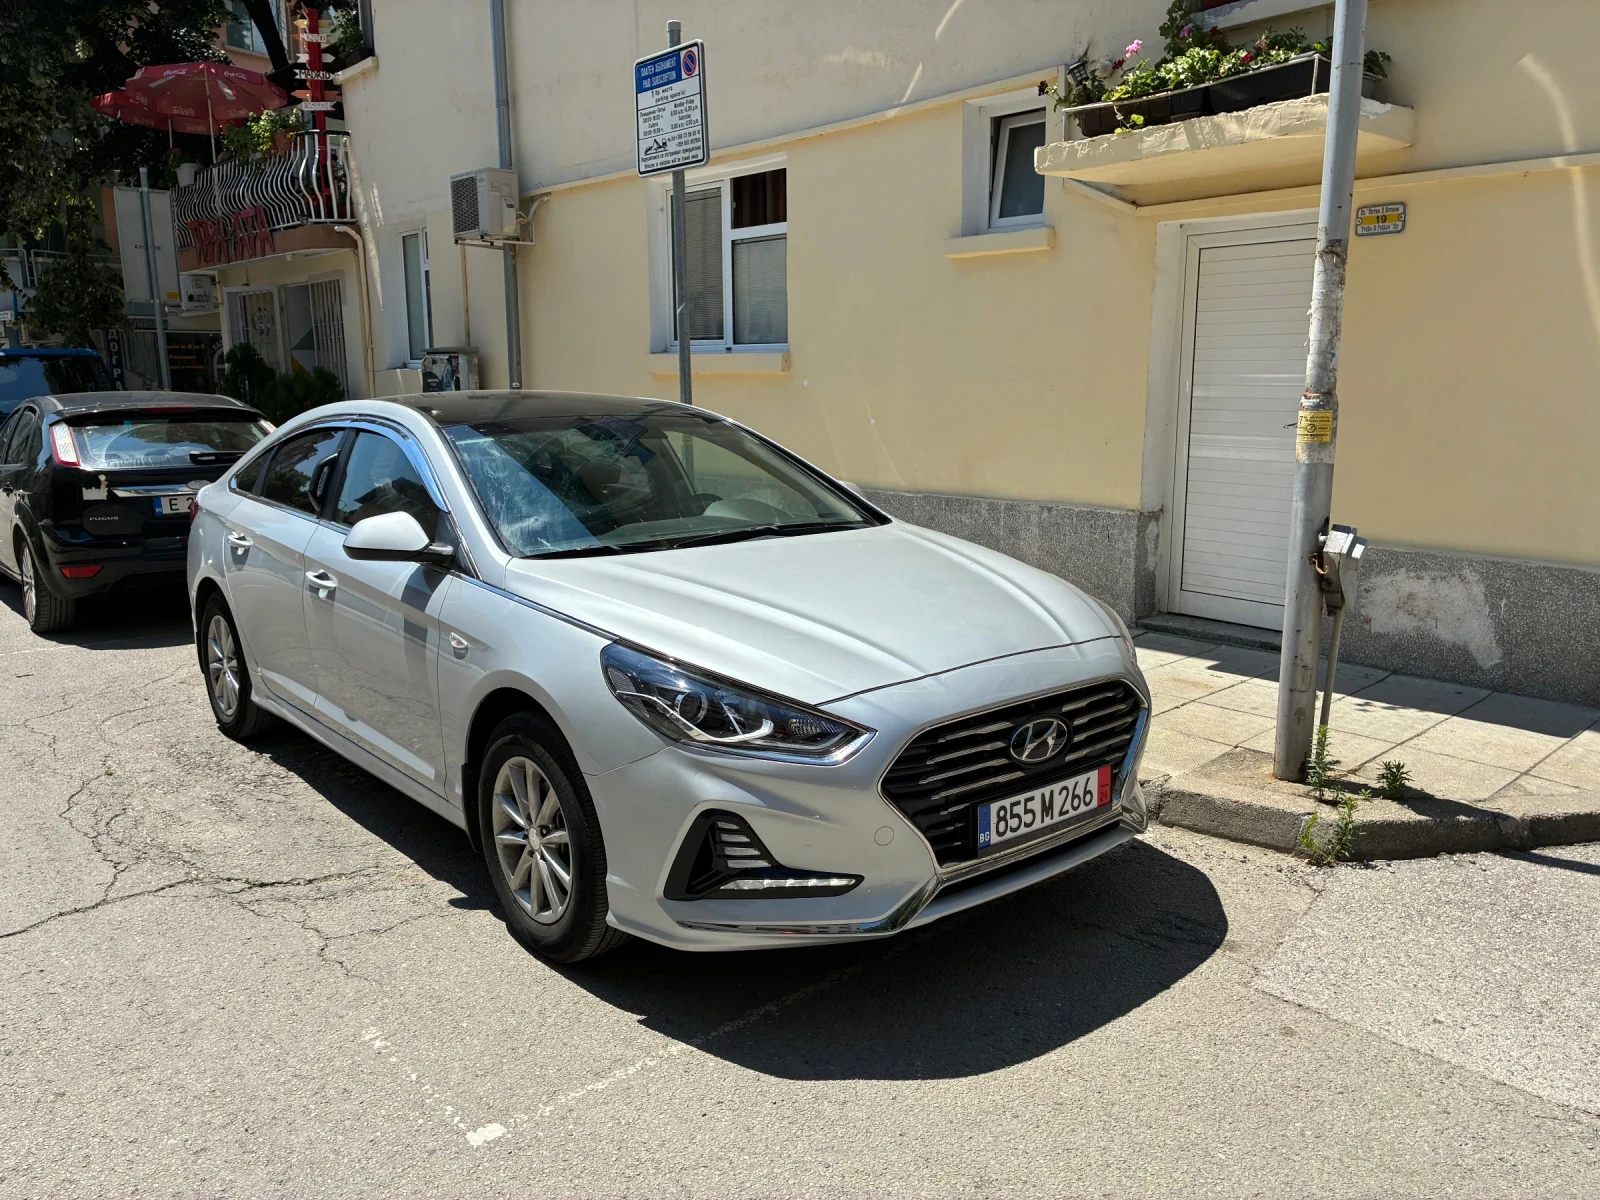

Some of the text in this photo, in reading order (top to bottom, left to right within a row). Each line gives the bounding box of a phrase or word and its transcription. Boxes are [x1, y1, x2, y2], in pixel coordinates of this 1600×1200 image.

[300, 33, 327, 43] MONACO
[299, 69, 331, 80] MADRID
[1376, 214, 1387, 224] 19
[168, 498, 180, 512] E
[979, 831, 990, 844] BG
[995, 796, 1036, 838] 855
[1058, 777, 1094, 818] 266
